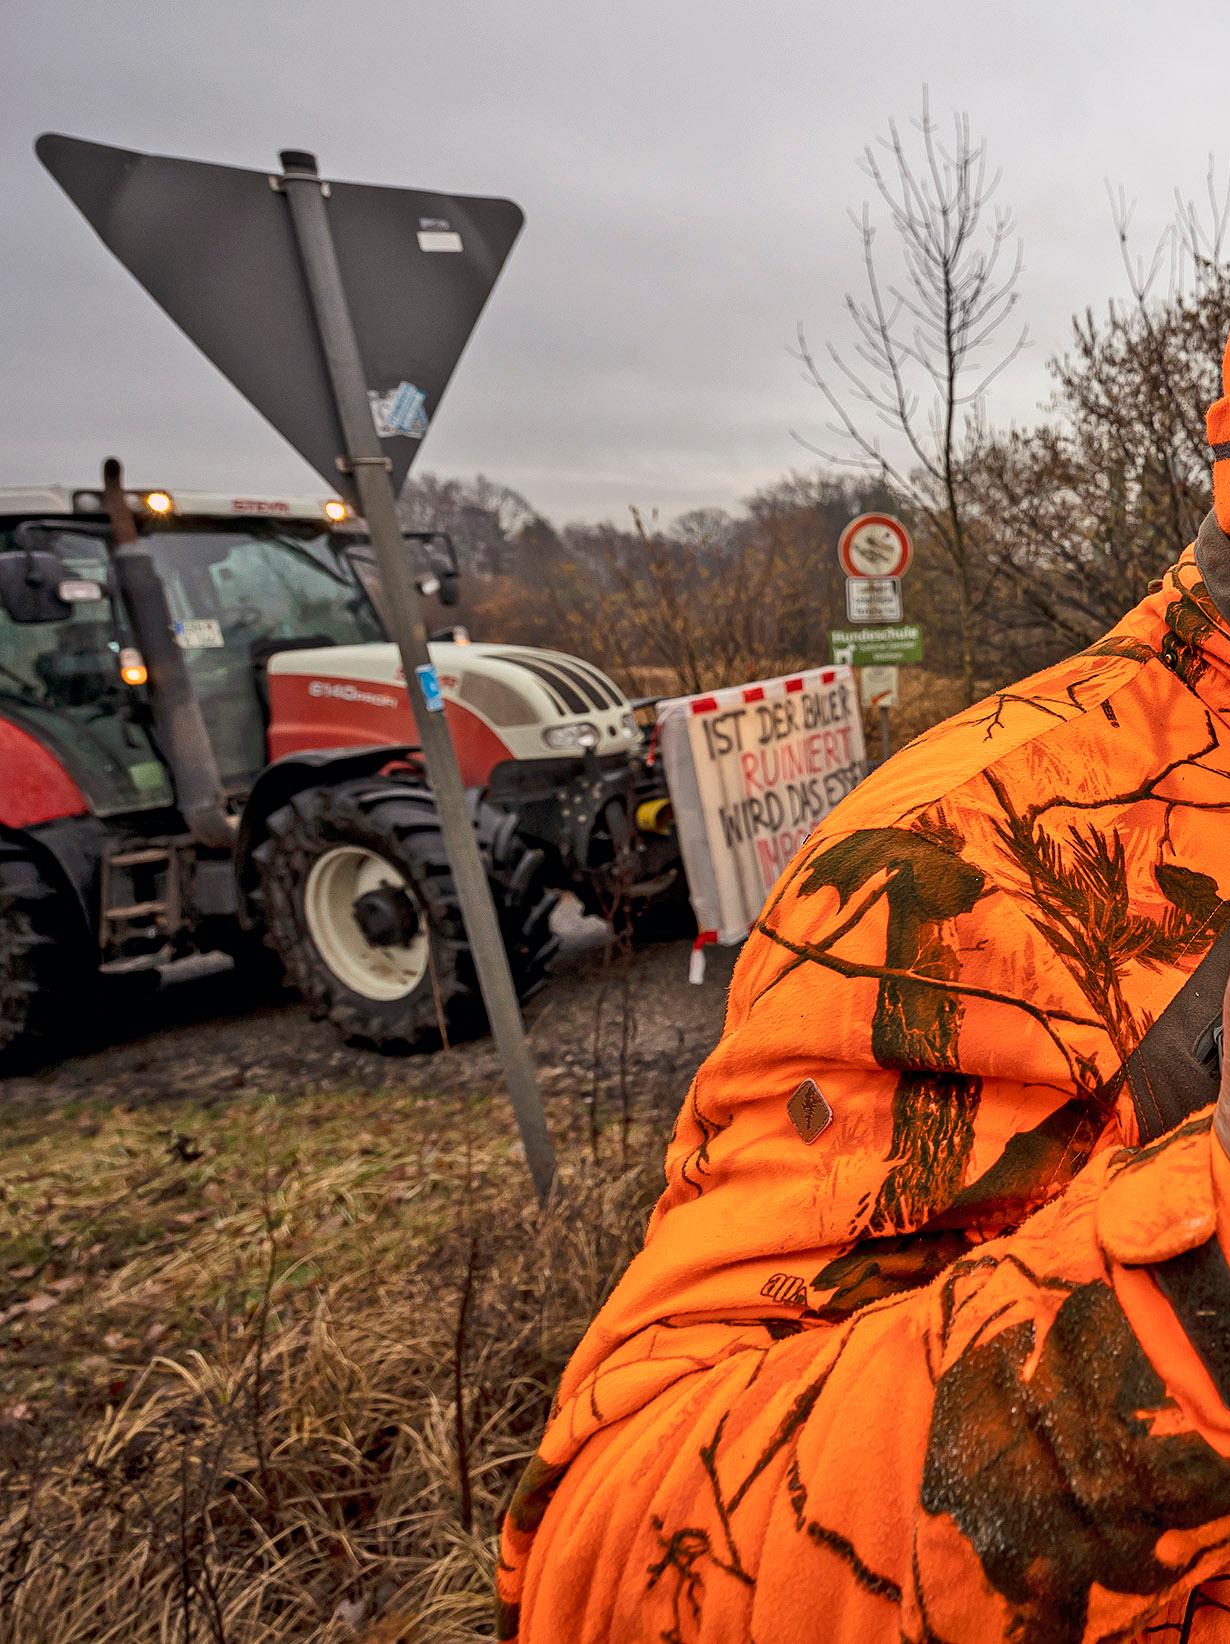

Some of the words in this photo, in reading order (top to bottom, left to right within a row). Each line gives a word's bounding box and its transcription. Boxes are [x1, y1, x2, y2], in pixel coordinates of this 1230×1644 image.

[703, 709, 746, 760] IST
[756, 700, 798, 744] DER
[802, 684, 851, 729] BAUER
[719, 791, 785, 848] WIRD
[787, 778, 823, 827] DAS
